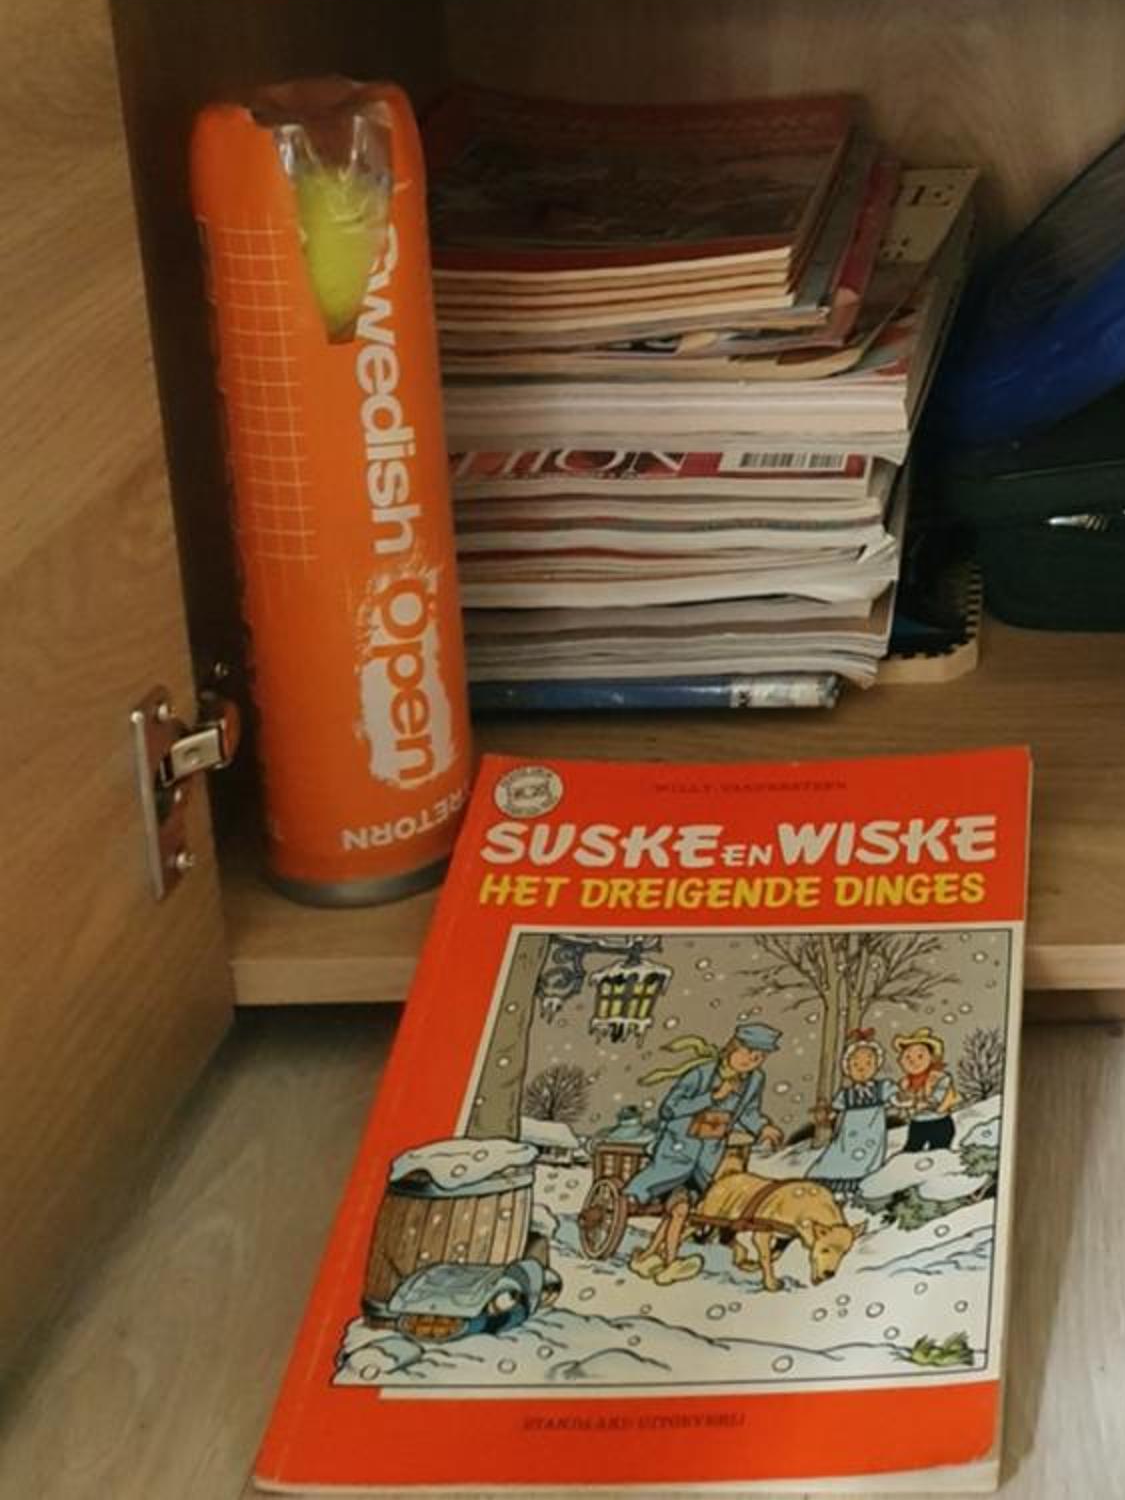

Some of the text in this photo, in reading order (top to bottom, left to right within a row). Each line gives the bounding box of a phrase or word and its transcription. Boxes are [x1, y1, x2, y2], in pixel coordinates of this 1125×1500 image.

[478, 814, 998, 869] SUSKE EN WISKE
[478, 872, 986, 910] HET DREIGENDE DINGES
